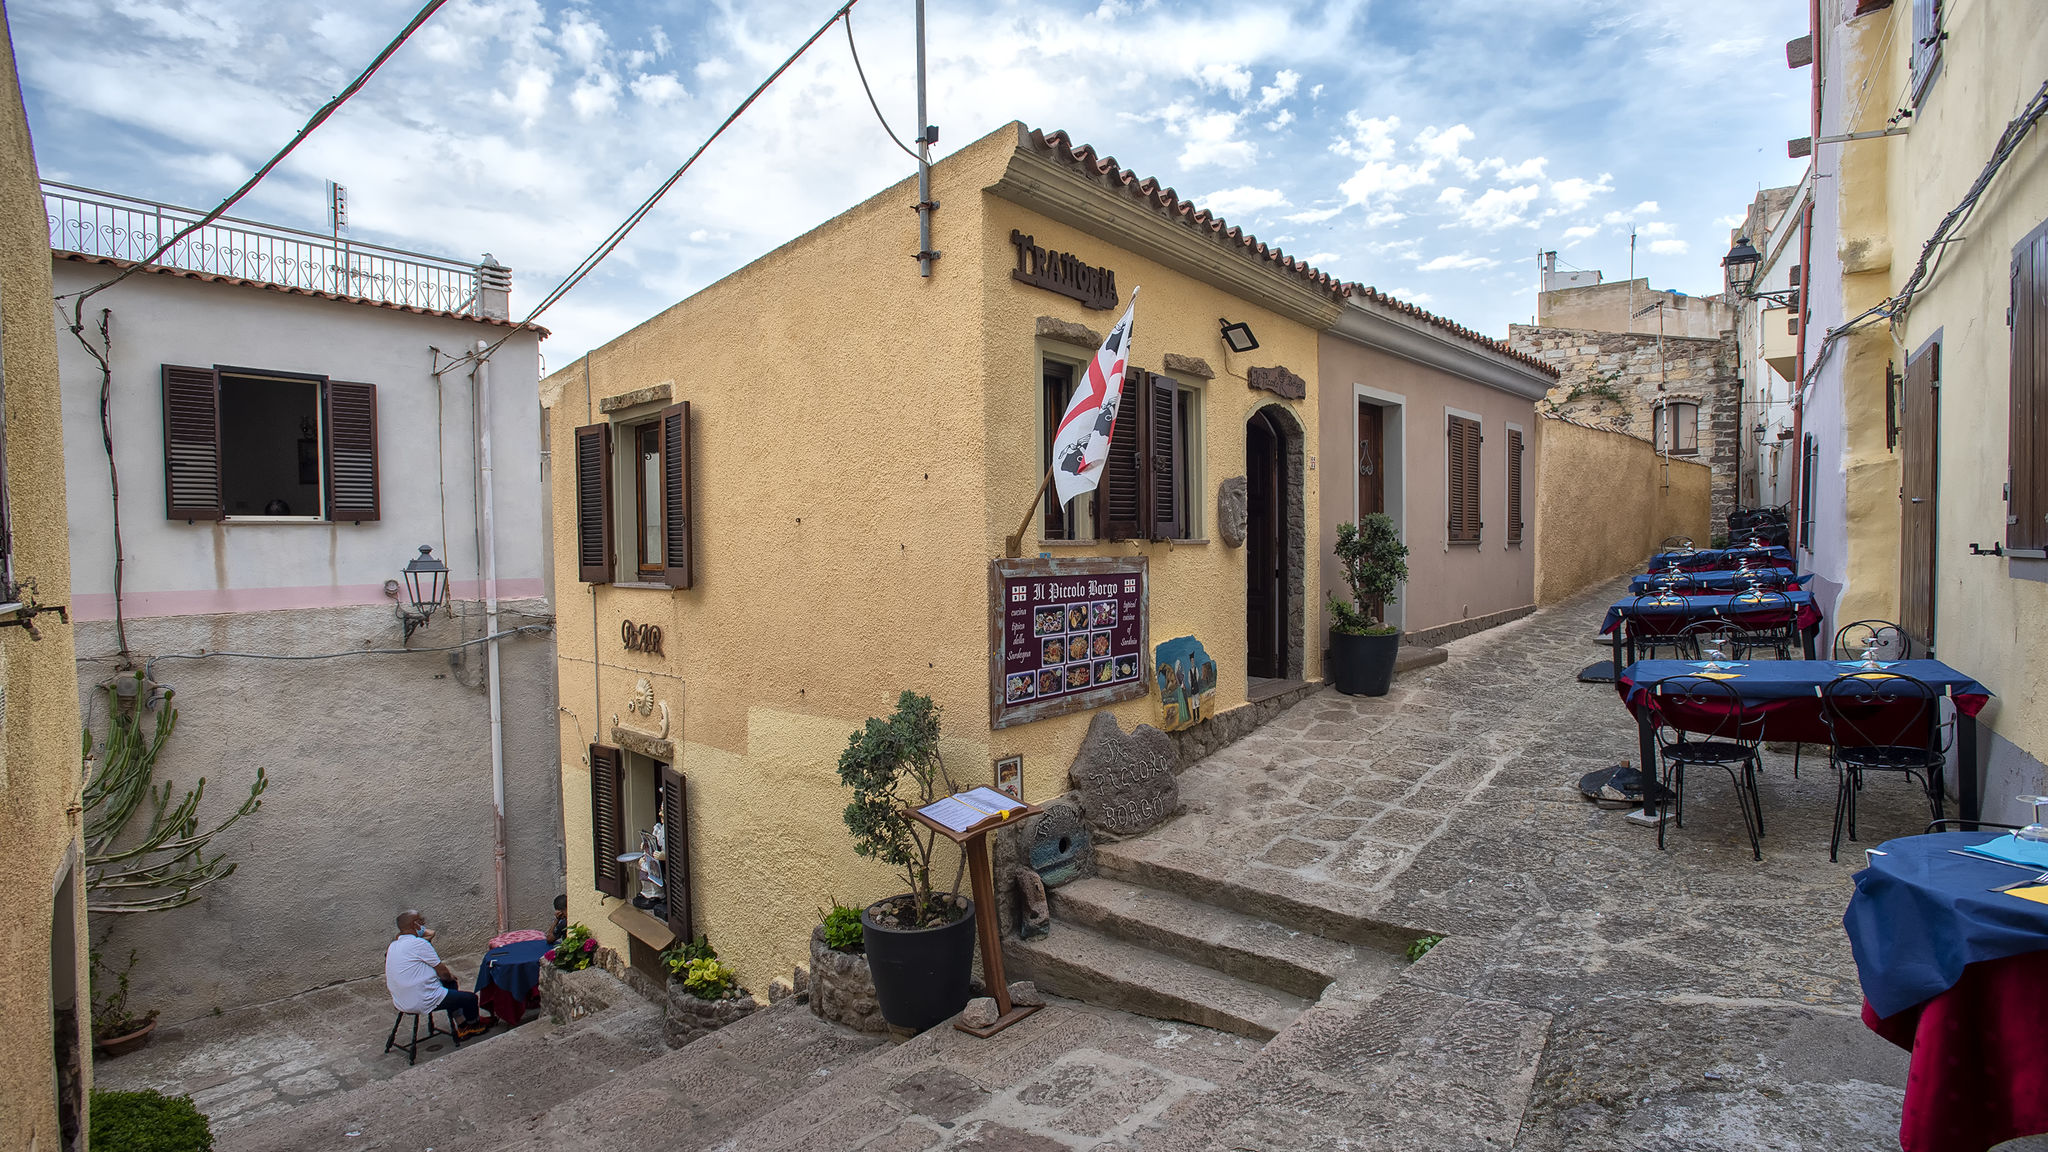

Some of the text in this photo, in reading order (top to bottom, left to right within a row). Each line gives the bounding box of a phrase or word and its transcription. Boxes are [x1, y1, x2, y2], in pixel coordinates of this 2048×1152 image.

[1032, 580, 1118, 602] Il Piccolo Borgo
